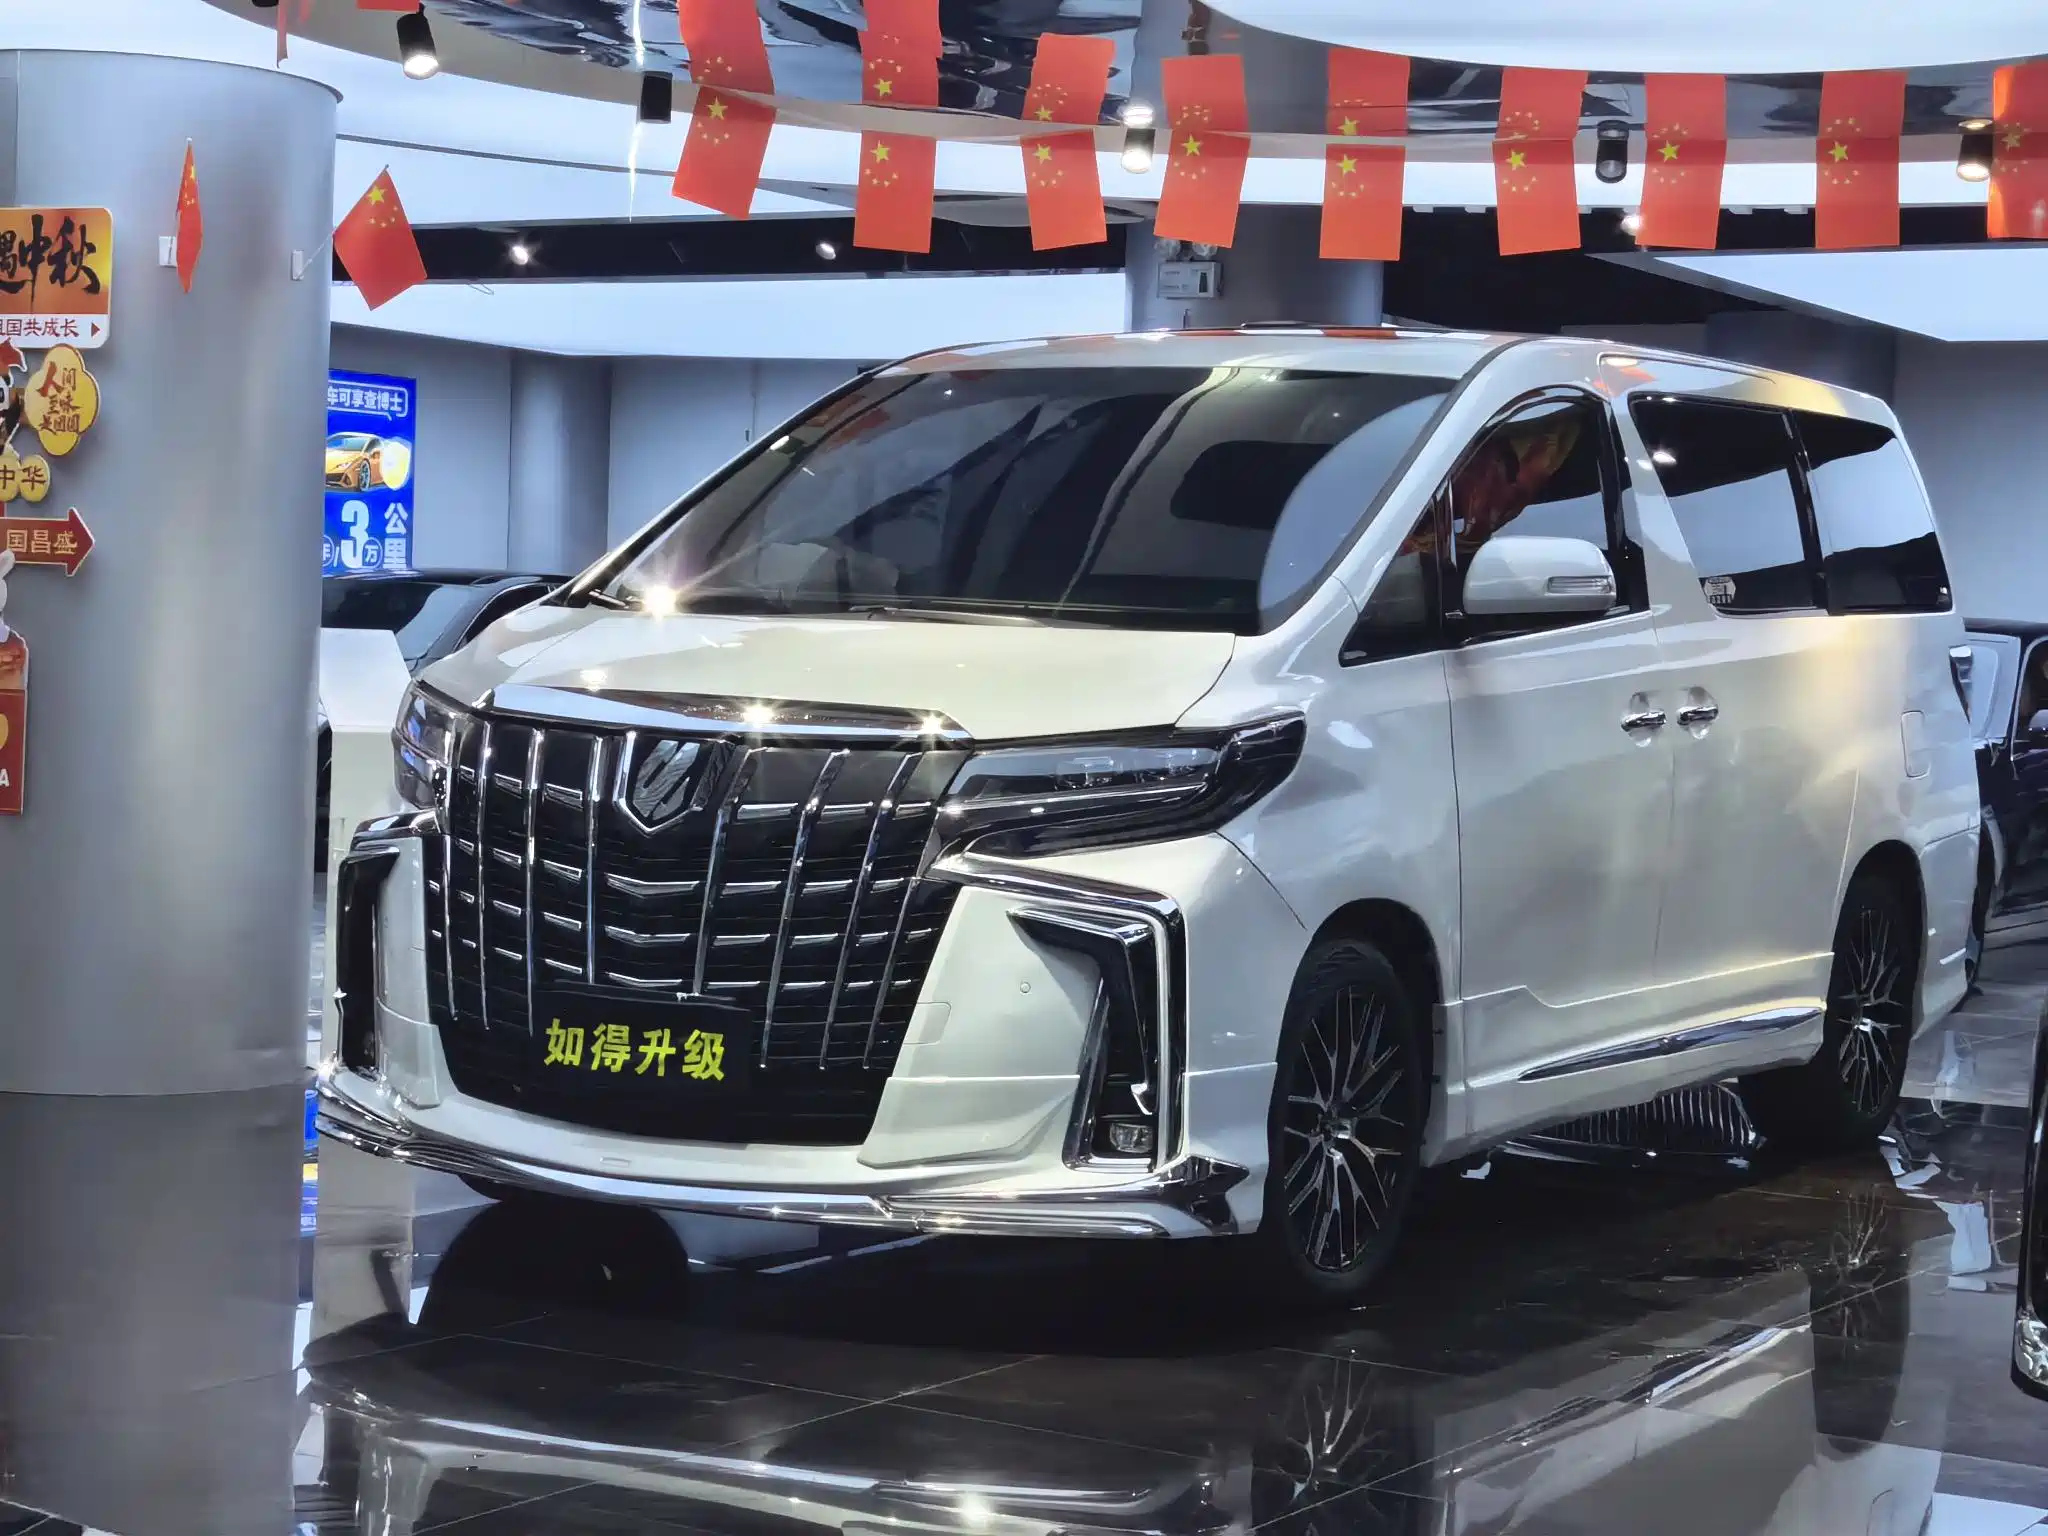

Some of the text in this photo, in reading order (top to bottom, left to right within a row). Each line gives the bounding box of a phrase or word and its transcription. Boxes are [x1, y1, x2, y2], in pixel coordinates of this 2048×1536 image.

[37, 361, 77, 397] 人间
[0, 464, 47, 491] 中华
[543, 1018, 726, 1081] 如得升级
